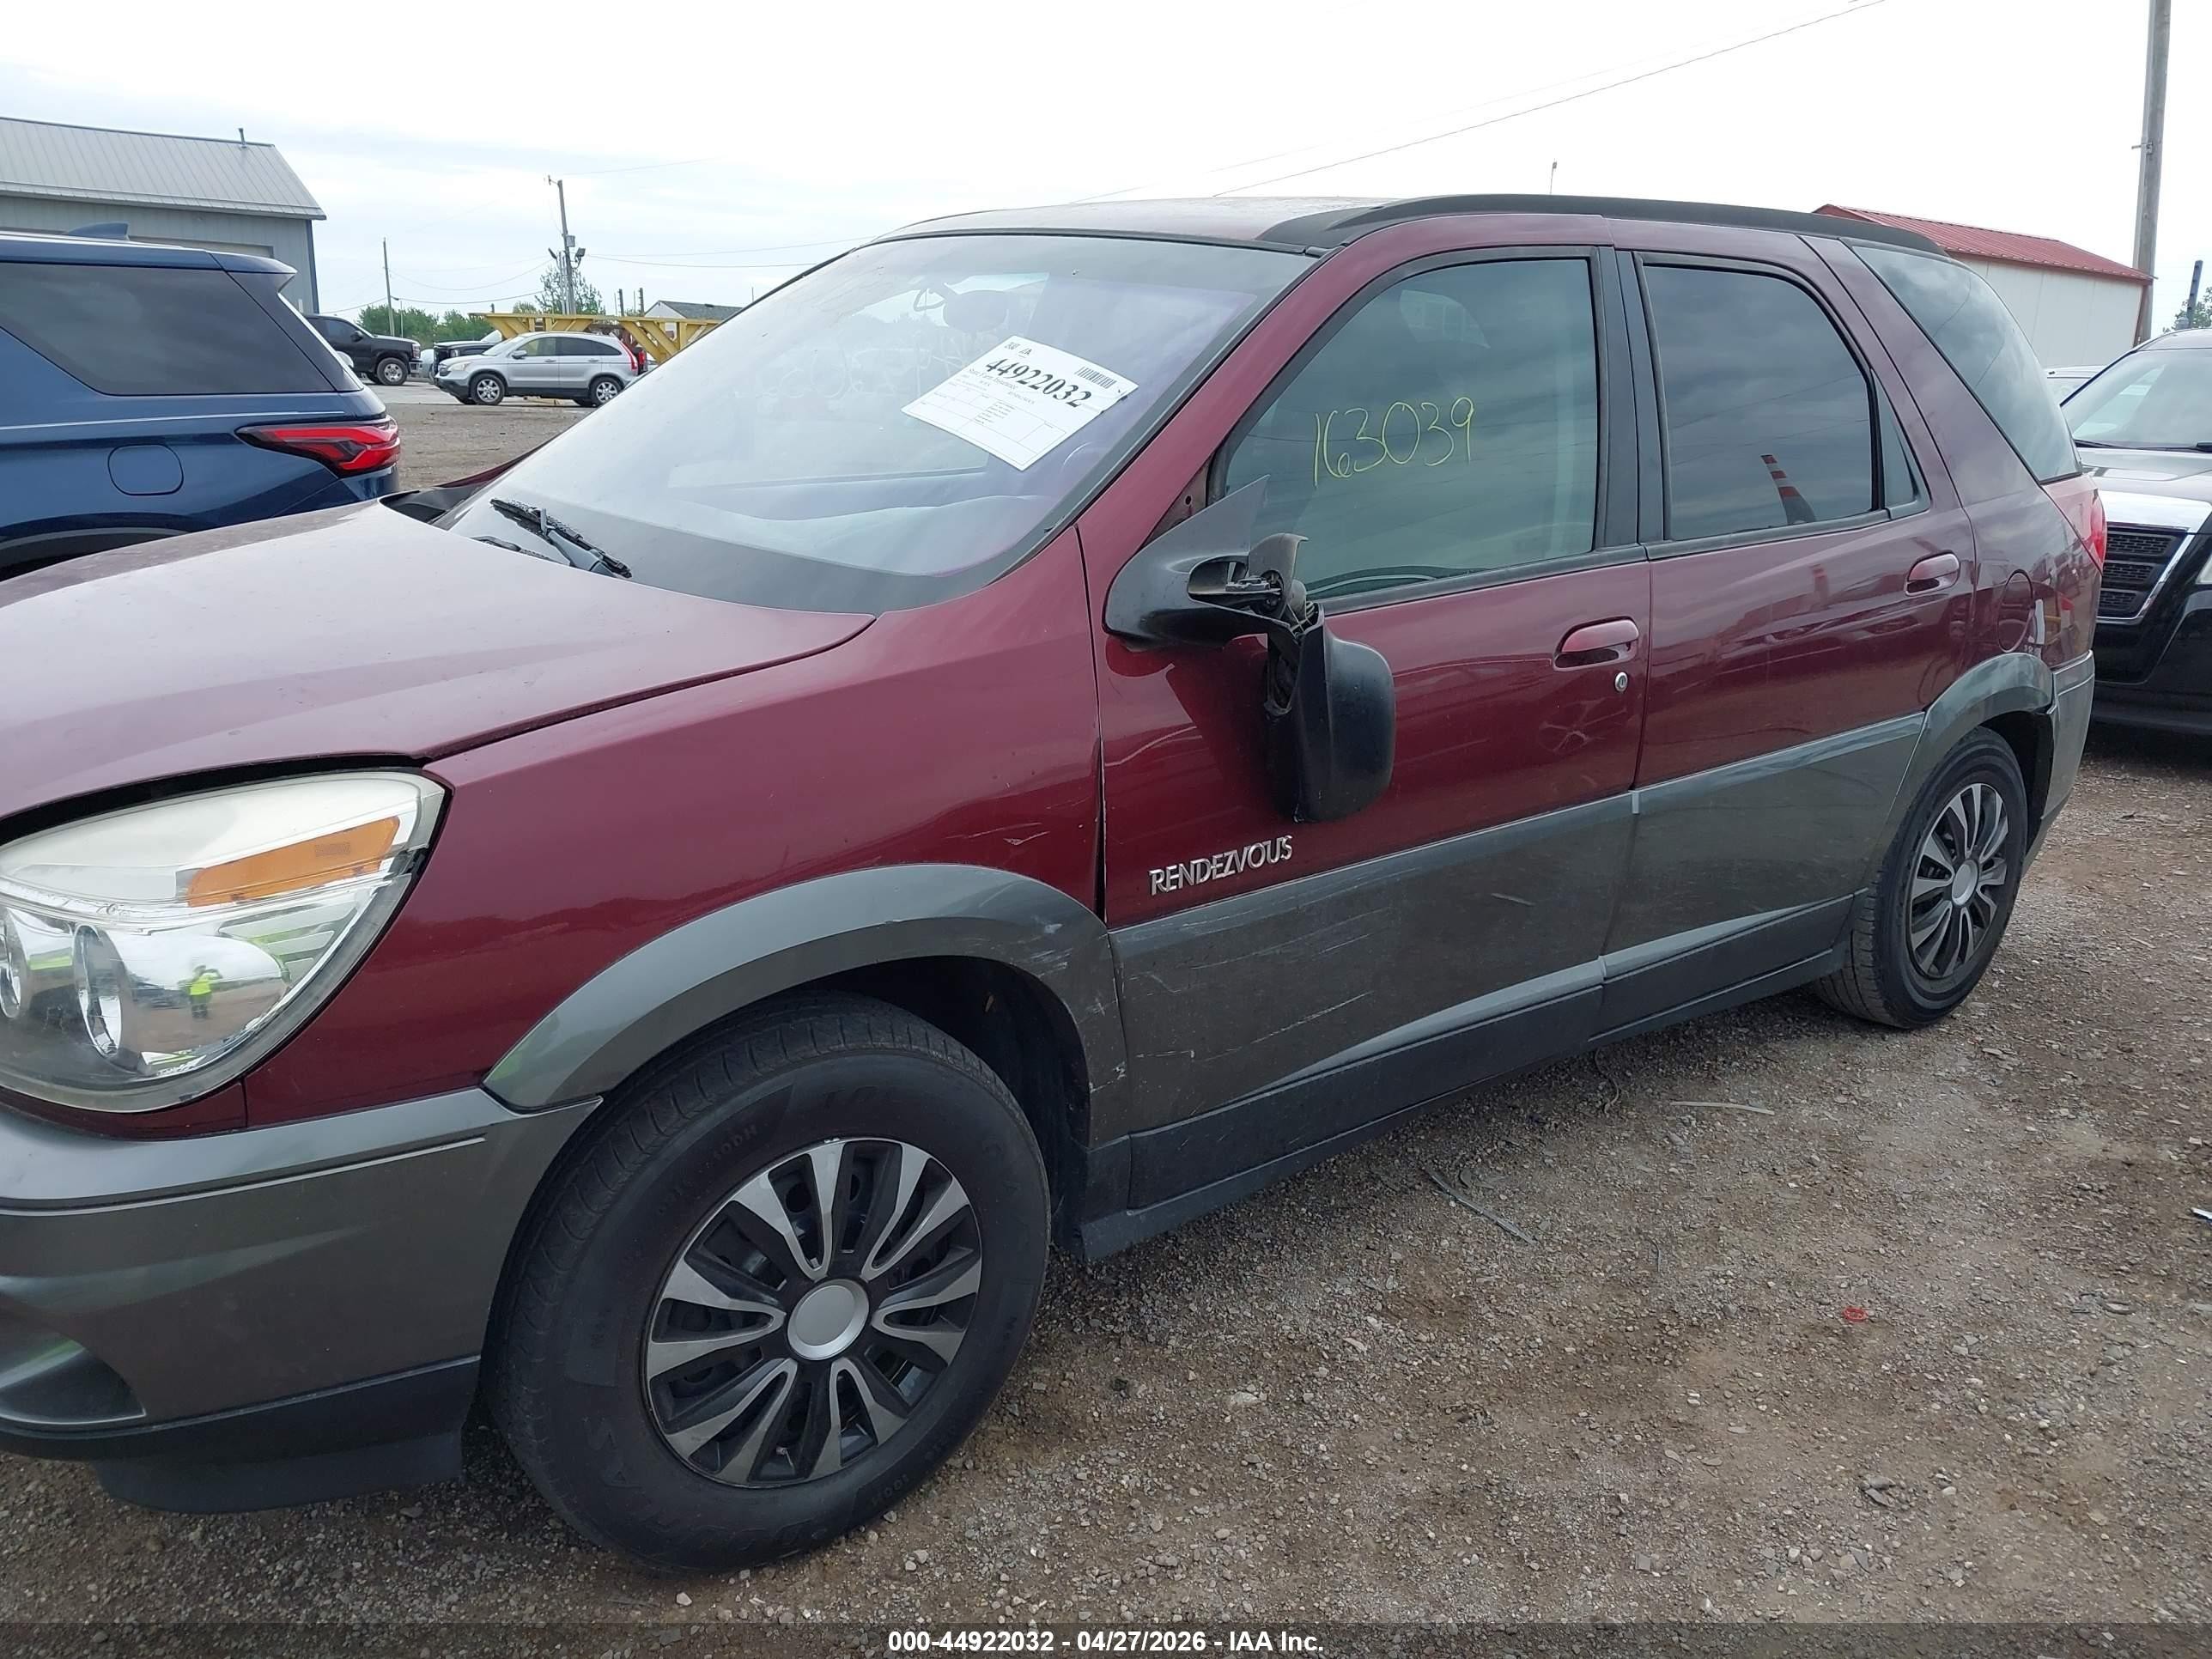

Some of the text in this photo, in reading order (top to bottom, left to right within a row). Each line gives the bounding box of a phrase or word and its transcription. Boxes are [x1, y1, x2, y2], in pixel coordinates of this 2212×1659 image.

[985, 357, 1092, 408] 44922032
[1313, 397, 1475, 488] 163039
[1148, 835, 1293, 896] RENDEZVOUS
